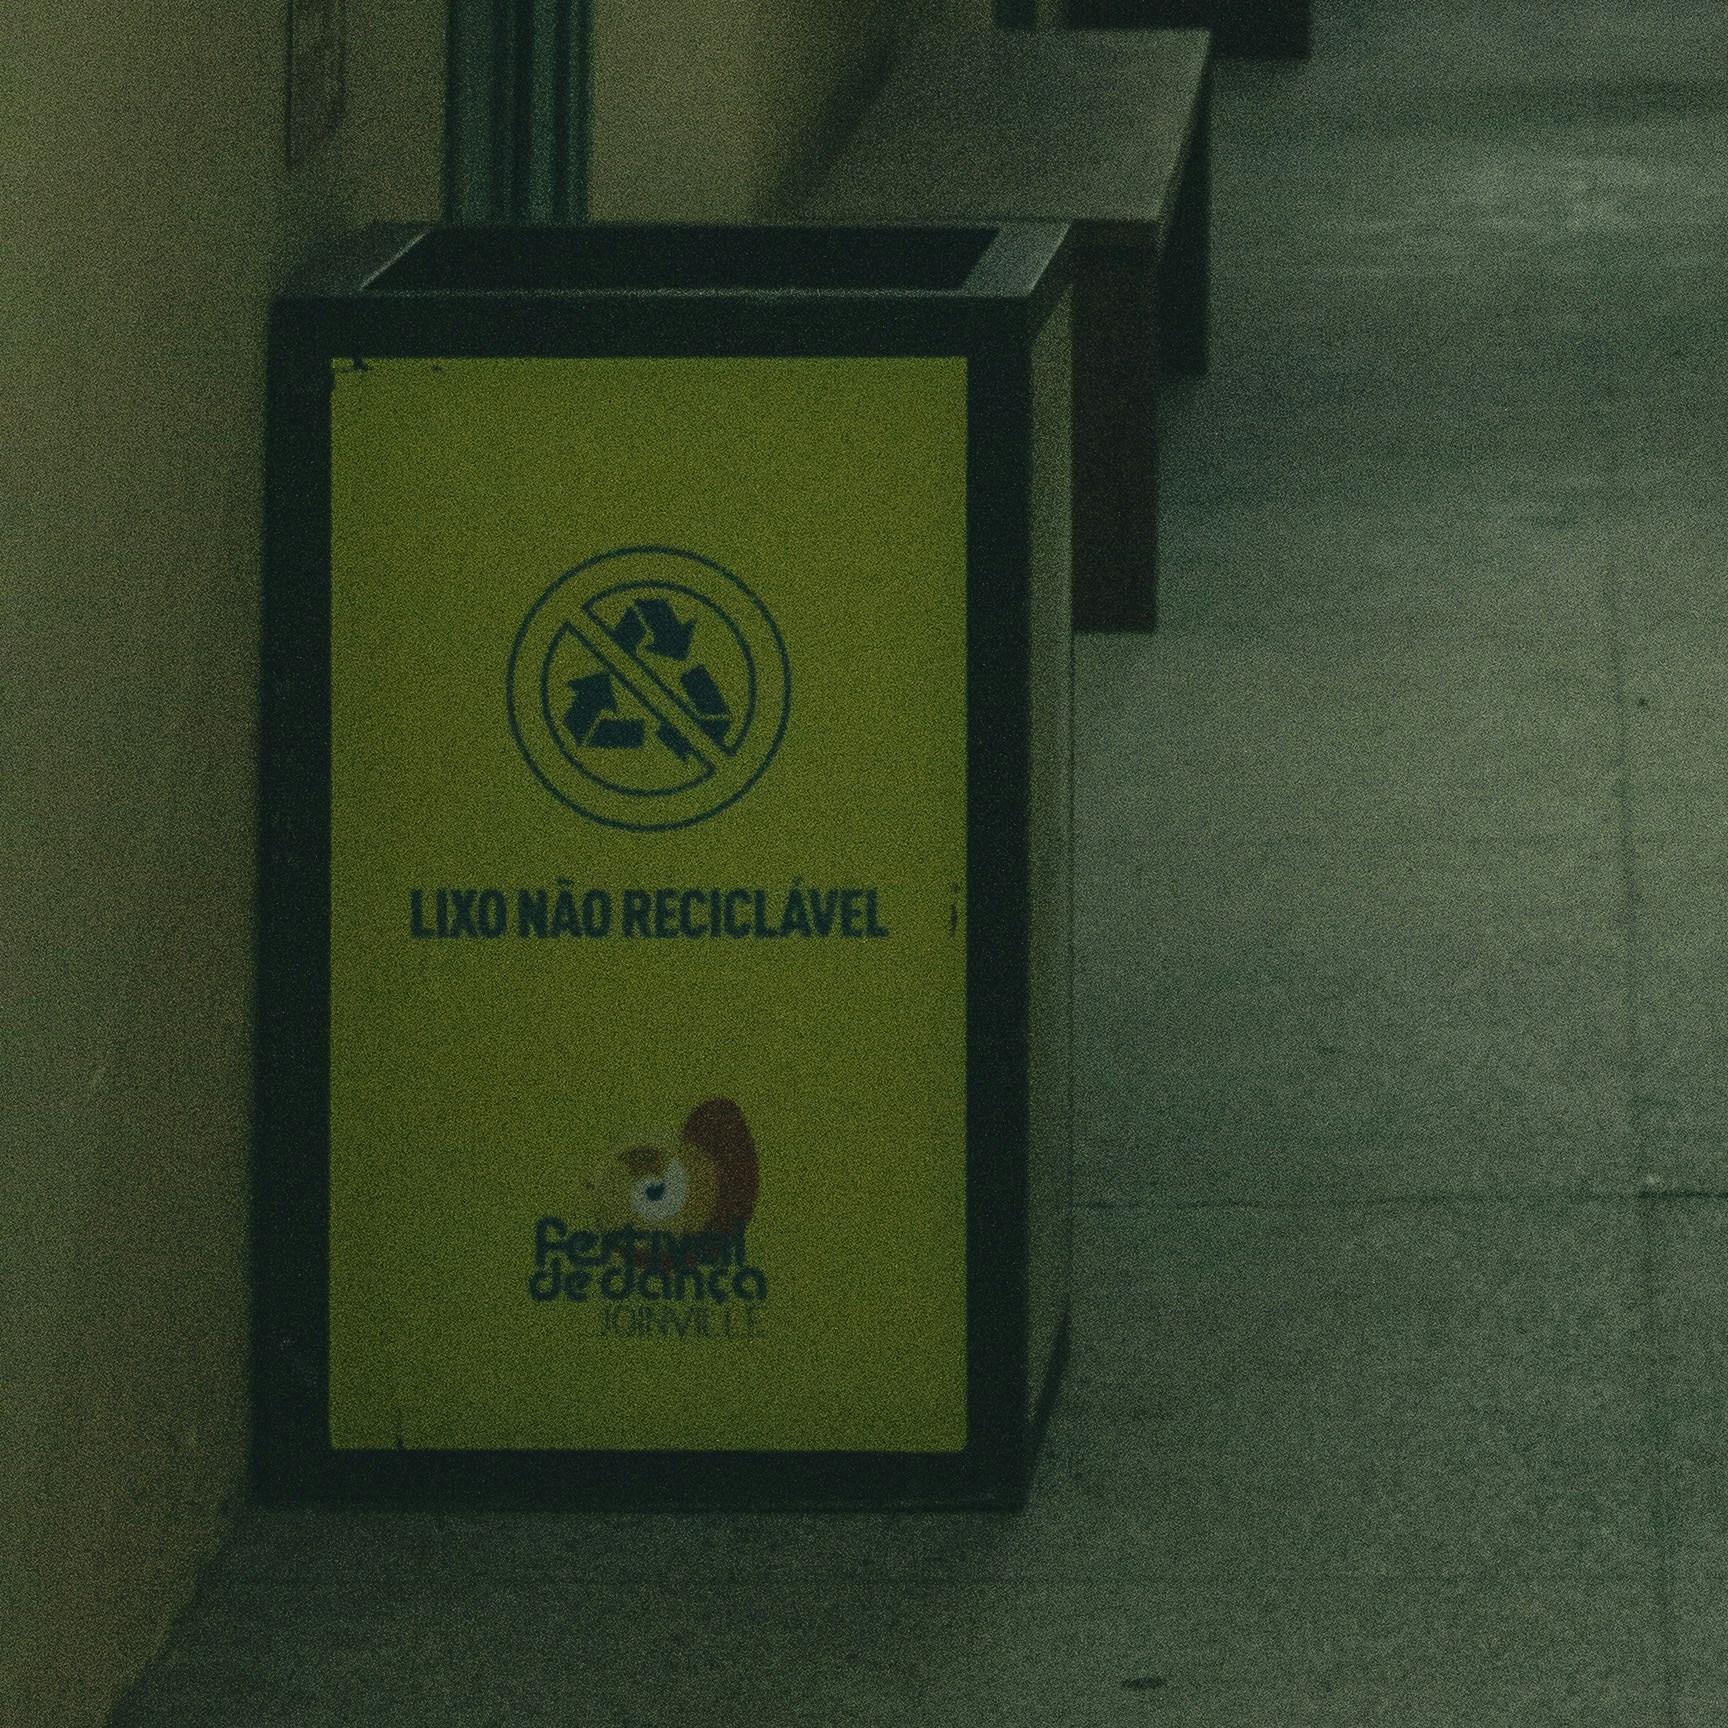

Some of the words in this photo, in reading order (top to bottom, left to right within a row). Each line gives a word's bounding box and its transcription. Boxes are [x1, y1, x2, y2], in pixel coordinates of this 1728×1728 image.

[410, 888, 507, 938] LIXO
[517, 877, 612, 938] NÃO
[623, 877, 889, 938] RECICLÁVEL
[600, 1305, 767, 1339] JOINVILLE
